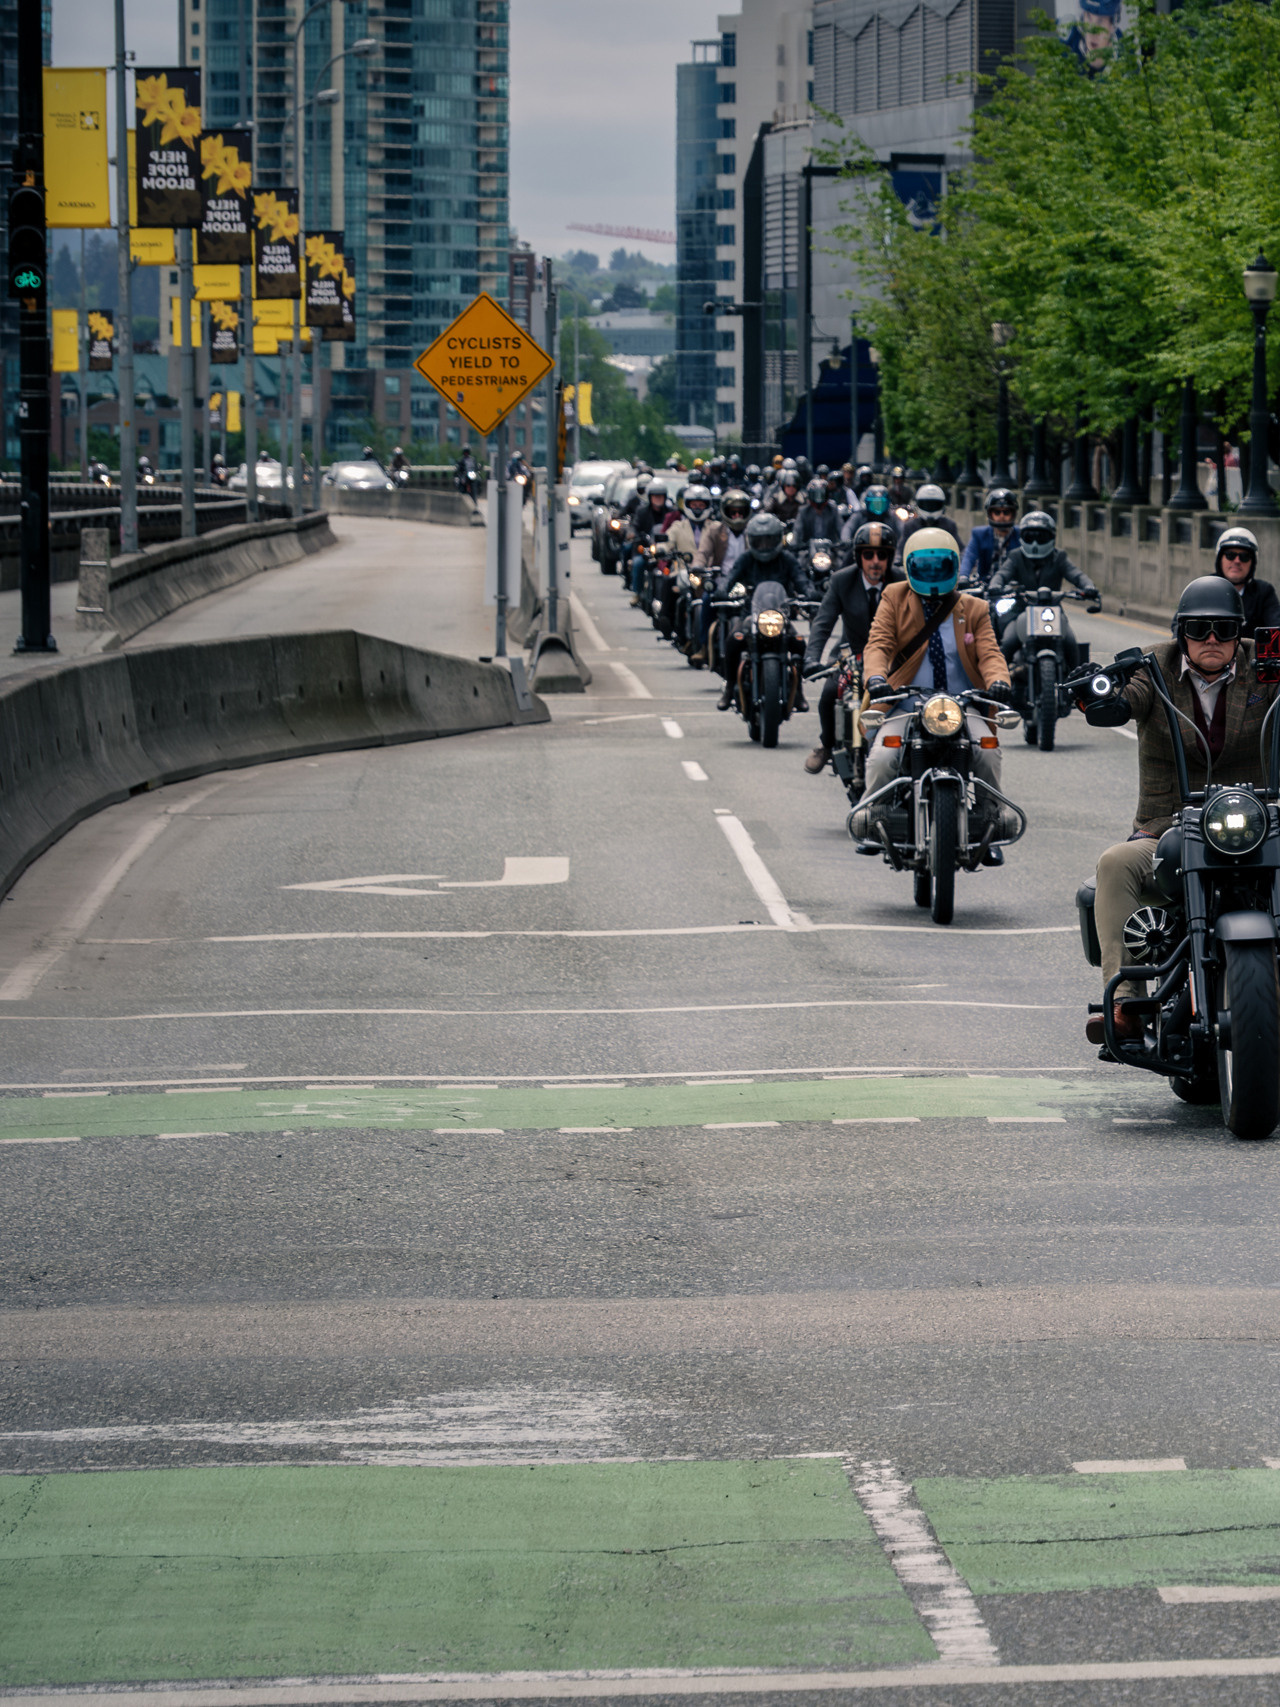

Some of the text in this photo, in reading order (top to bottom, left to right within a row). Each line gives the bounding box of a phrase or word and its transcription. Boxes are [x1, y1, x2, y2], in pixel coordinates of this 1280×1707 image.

[447, 337, 522, 349] CYCLISTS
[448, 356, 520, 369] YIELD TO
[441, 375, 528, 386] PEDESTRIANS
